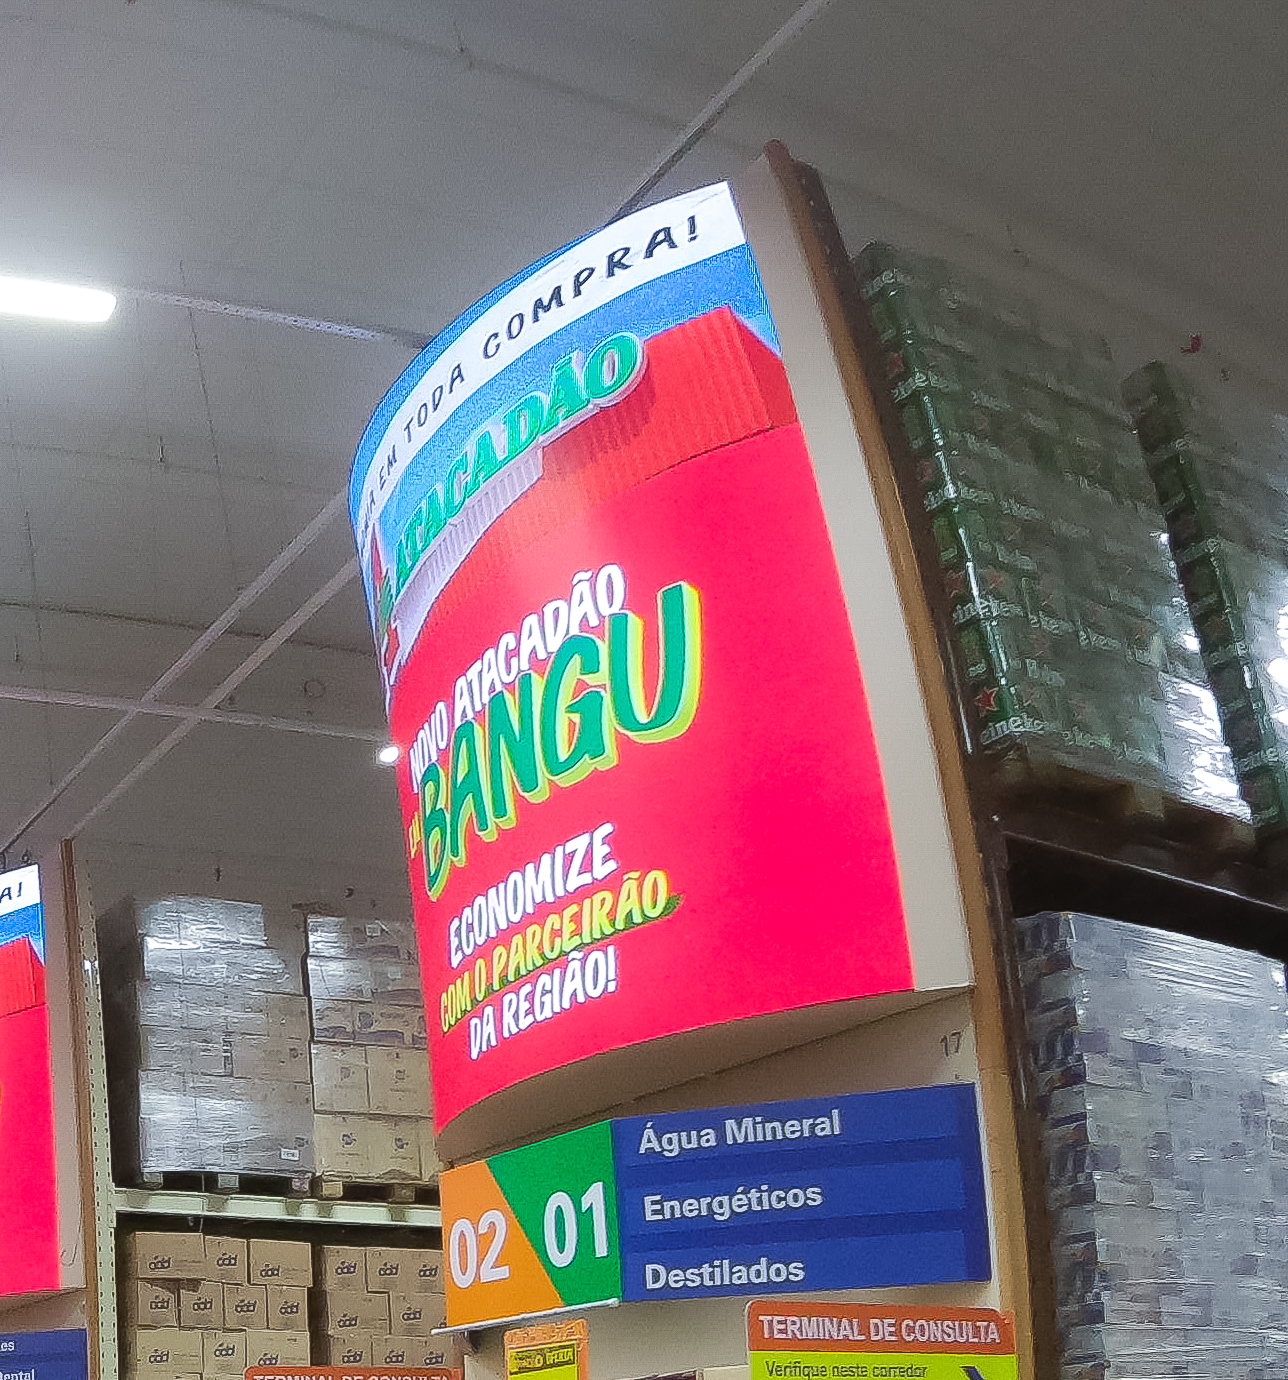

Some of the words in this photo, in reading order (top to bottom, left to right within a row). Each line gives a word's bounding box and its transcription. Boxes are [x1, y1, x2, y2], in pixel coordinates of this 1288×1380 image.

[377, 446, 398, 489] EM
[402, 362, 466, 445] TODA
[482, 215, 699, 360] COMPRA!
[394, 331, 646, 589] ATACADÃO
[410, 701, 448, 793] NOVO
[454, 563, 625, 725] ATACADÃO
[420, 581, 704, 900] BANGU
[440, 971, 471, 1033] COM
[475, 958, 487, 1001] O
[492, 869, 669, 990] PARCEIRÃO
[449, 822, 619, 969] ECONOMIZE
[469, 1005, 498, 1060] DA
[502, 945, 618, 1039] REGIÃO!
[639, 1120, 717, 1159] Água
[726, 1109, 842, 1146] Mineral
[448, 1208, 511, 1289] 02
[544, 1181, 610, 1268] 01
[644, 1183, 824, 1222] Energéticos
[645, 1256, 805, 1290] Destilados
[759, 1315, 866, 1341] TERMINAL
[869, 1318, 897, 1341] DE
[902, 1319, 1001, 1343] CONSULTA
[766, 1360, 827, 1380] Verifique
[832, 1364, 868, 1378] neste
[872, 1365, 928, 1378] corredor
